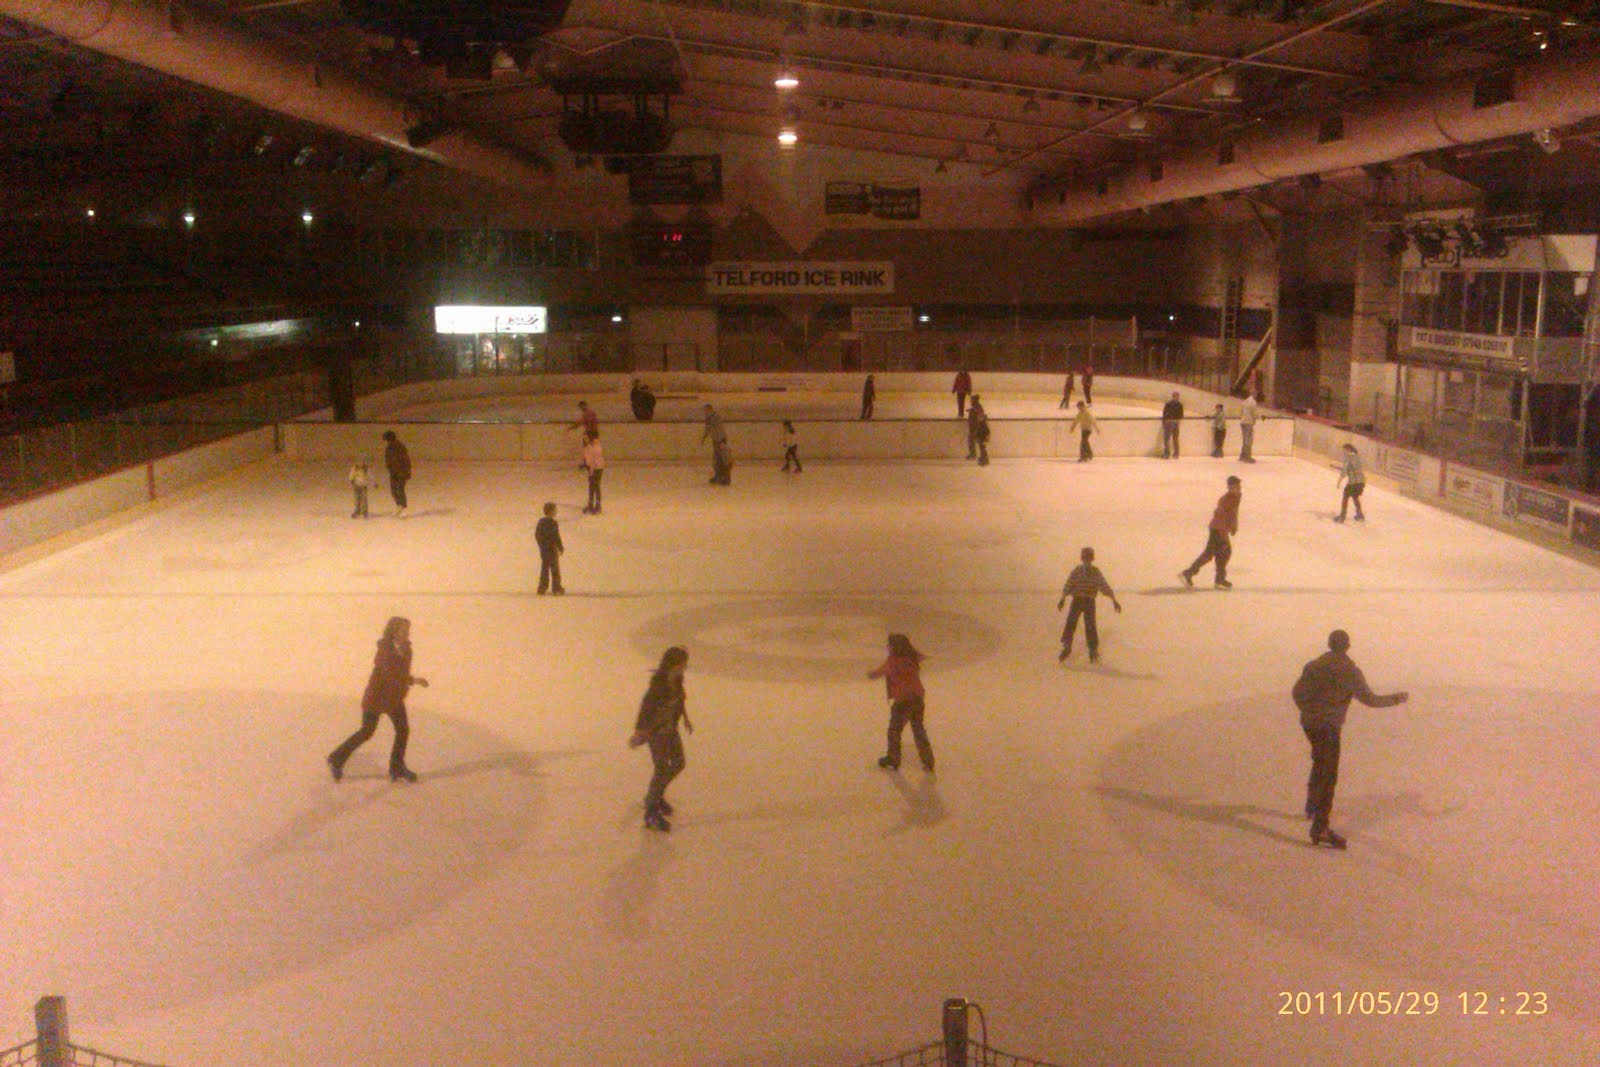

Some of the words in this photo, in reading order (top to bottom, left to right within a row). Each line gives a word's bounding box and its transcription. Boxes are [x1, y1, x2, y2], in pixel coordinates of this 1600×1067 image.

[712, 270, 800, 287] TELFORD
[804, 270, 837, 287] ICE
[840, 270, 886, 287] RINK
